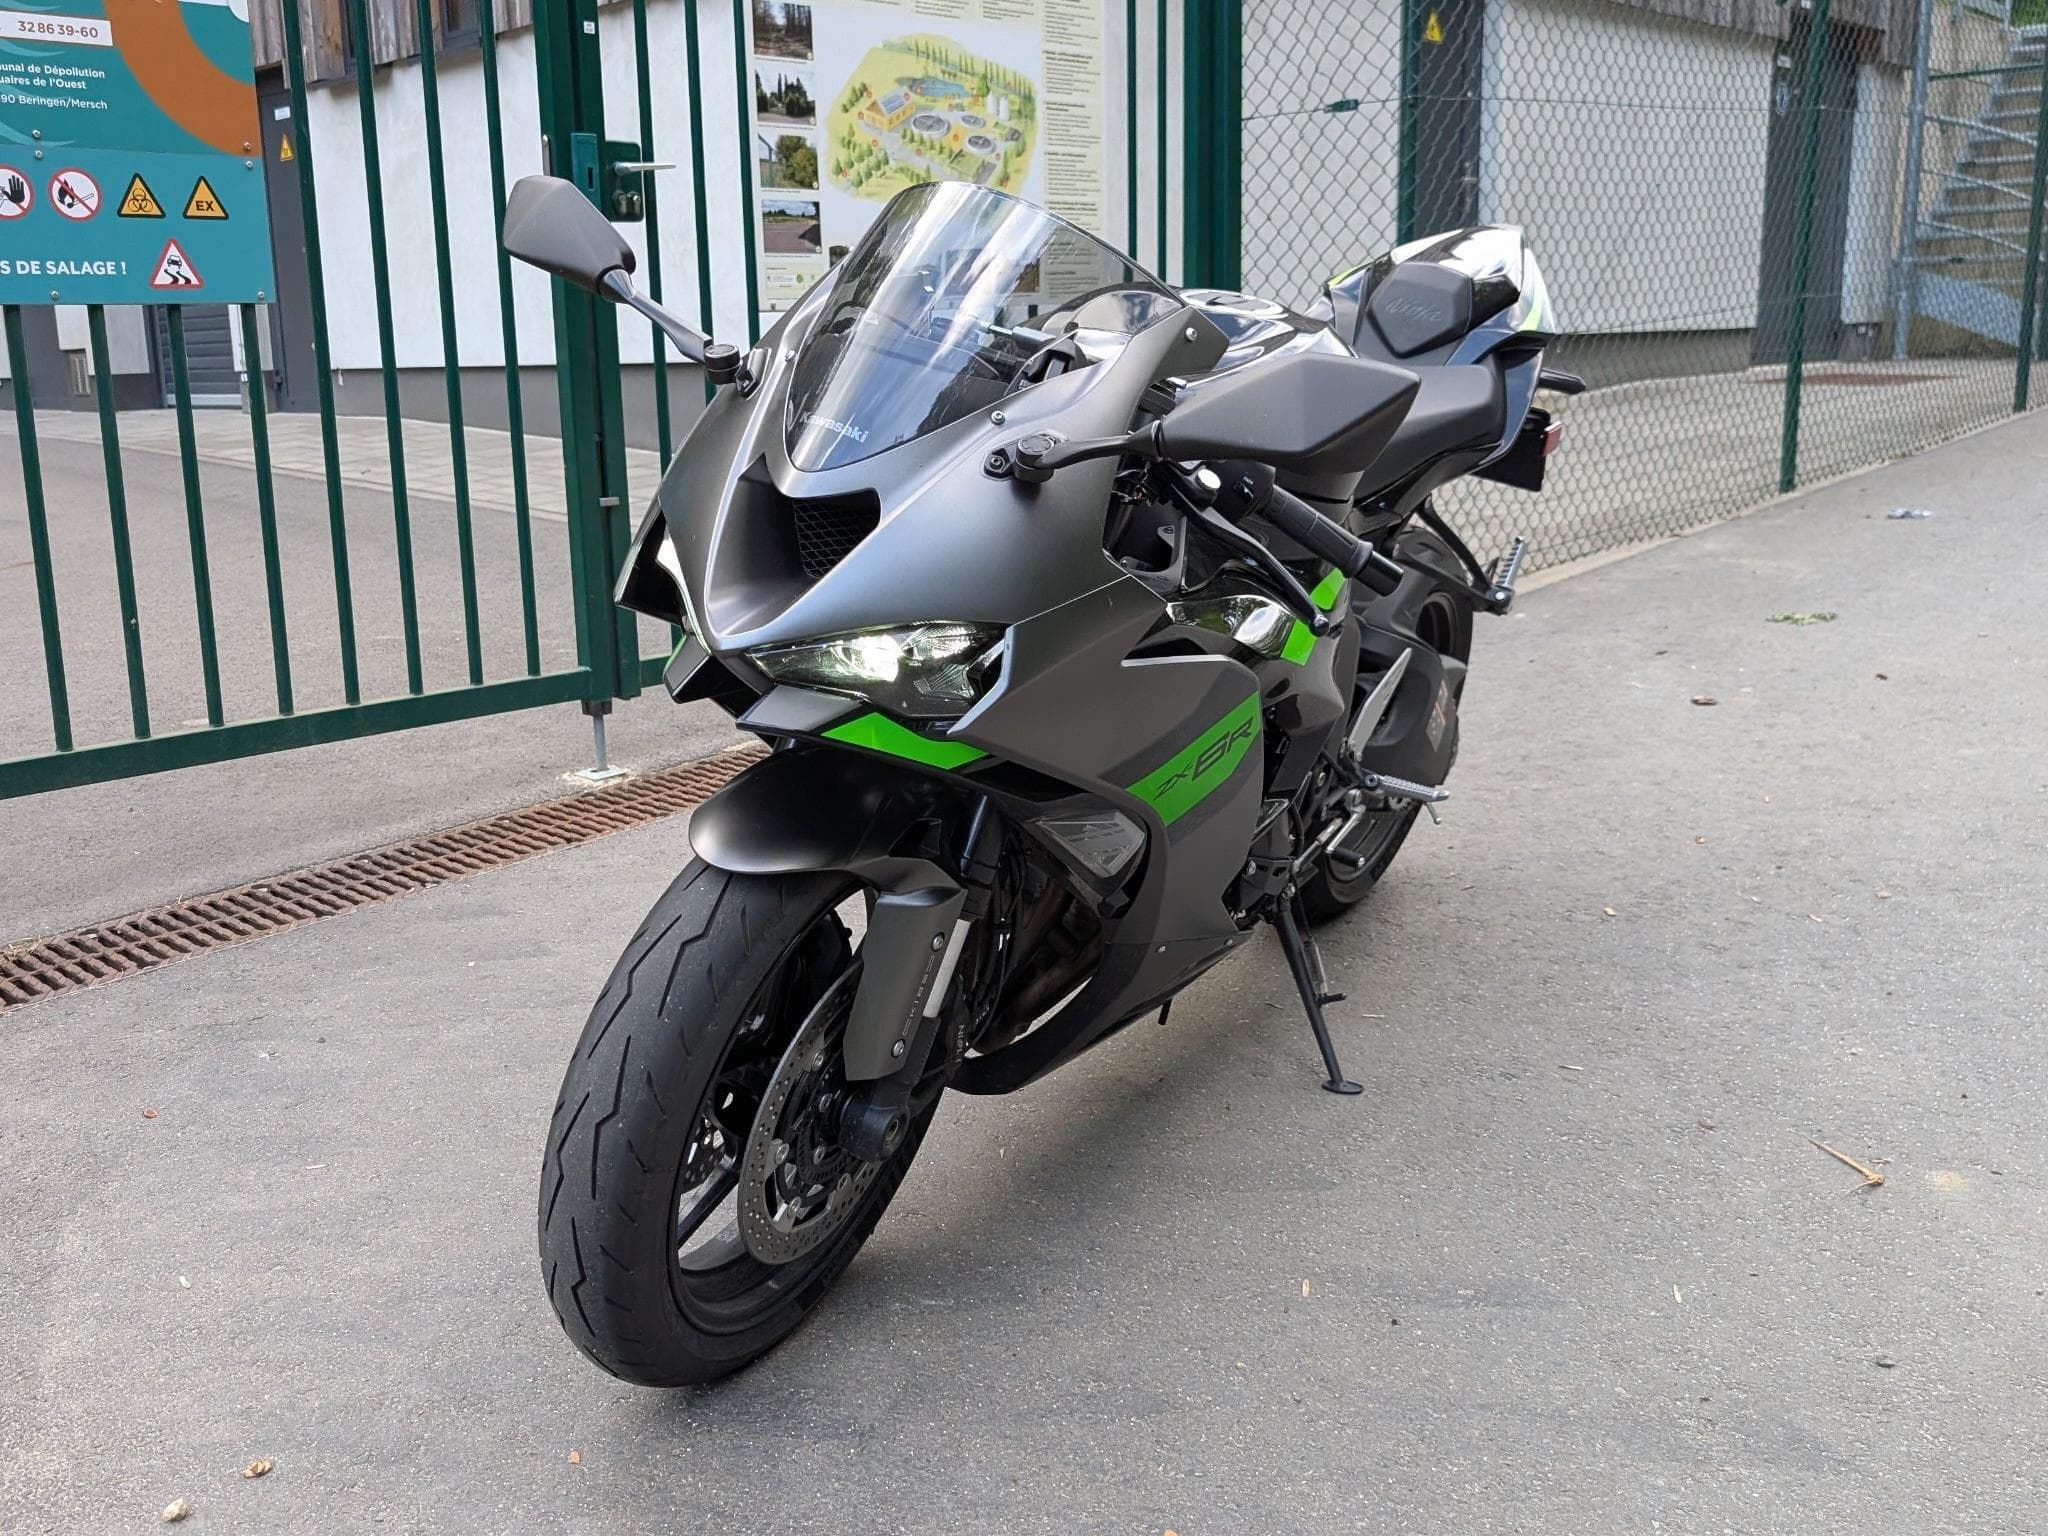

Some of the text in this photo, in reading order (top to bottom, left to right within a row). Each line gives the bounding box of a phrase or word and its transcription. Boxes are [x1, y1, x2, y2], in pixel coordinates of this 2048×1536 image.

[0, 63, 105, 79] unal de Dépollution
[33, 77, 47, 87] de
[49, 77, 87, 90] l'Ouest
[19, 95, 108, 110] Beringen/Mersch
[195, 201, 215, 212] EX
[0, 260, 11, 275] S
[16, 260, 42, 275] DE
[46, 260, 117, 275] SALAGE
[800, 411, 870, 443] Kawasaki
